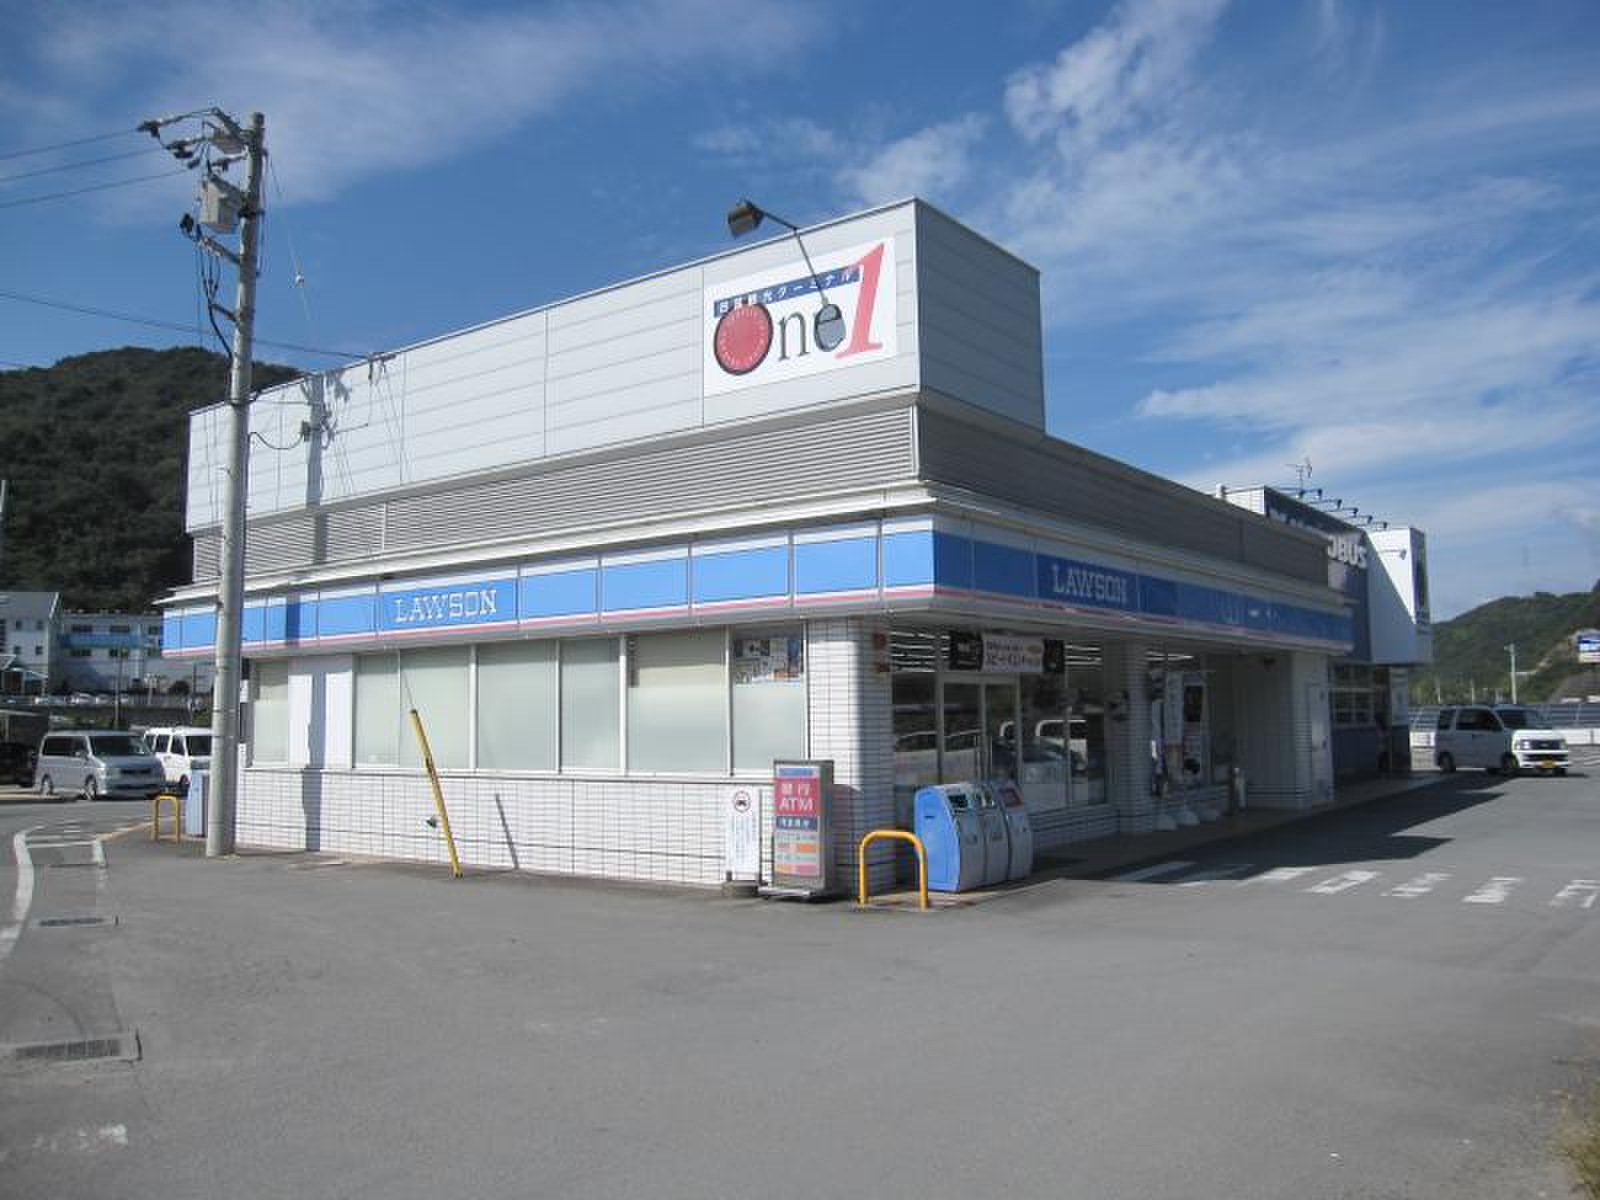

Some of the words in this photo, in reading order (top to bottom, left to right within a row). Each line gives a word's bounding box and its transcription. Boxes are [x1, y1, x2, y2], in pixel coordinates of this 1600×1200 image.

[1052, 563, 1127, 606] LAWSON
[395, 588, 497, 622] LAWSON
[779, 797, 814, 812] ATM
